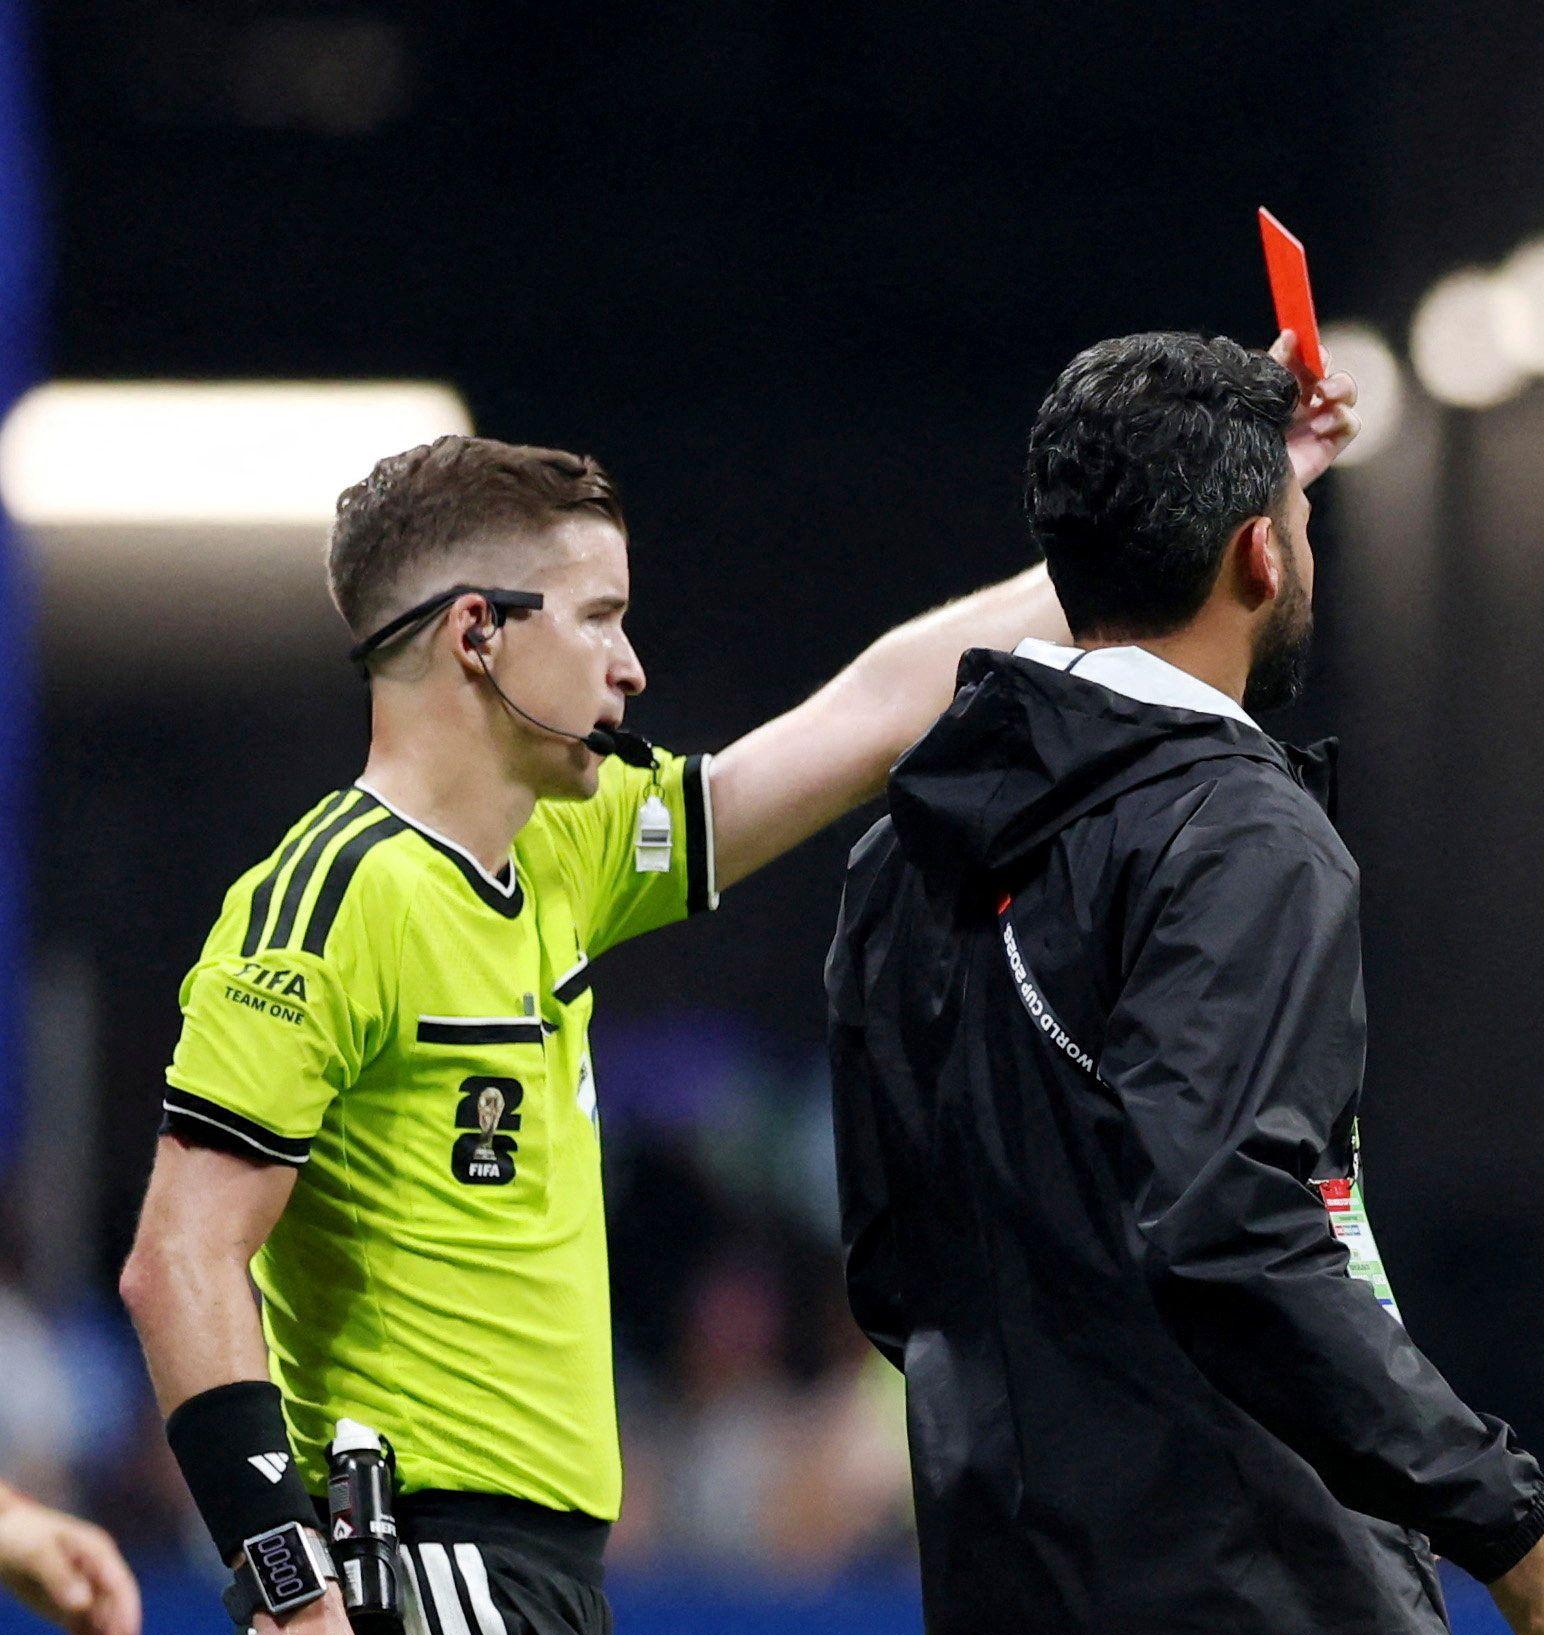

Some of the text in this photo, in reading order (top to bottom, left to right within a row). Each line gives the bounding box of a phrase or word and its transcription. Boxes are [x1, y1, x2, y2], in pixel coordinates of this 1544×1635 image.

[225, 986, 305, 1026] TEAM ONE
[1003, 922, 1094, 1072] WORLD CUP 2026
[468, 1162, 501, 1178] FIFA
[258, 1534, 304, 1598] 00:00
